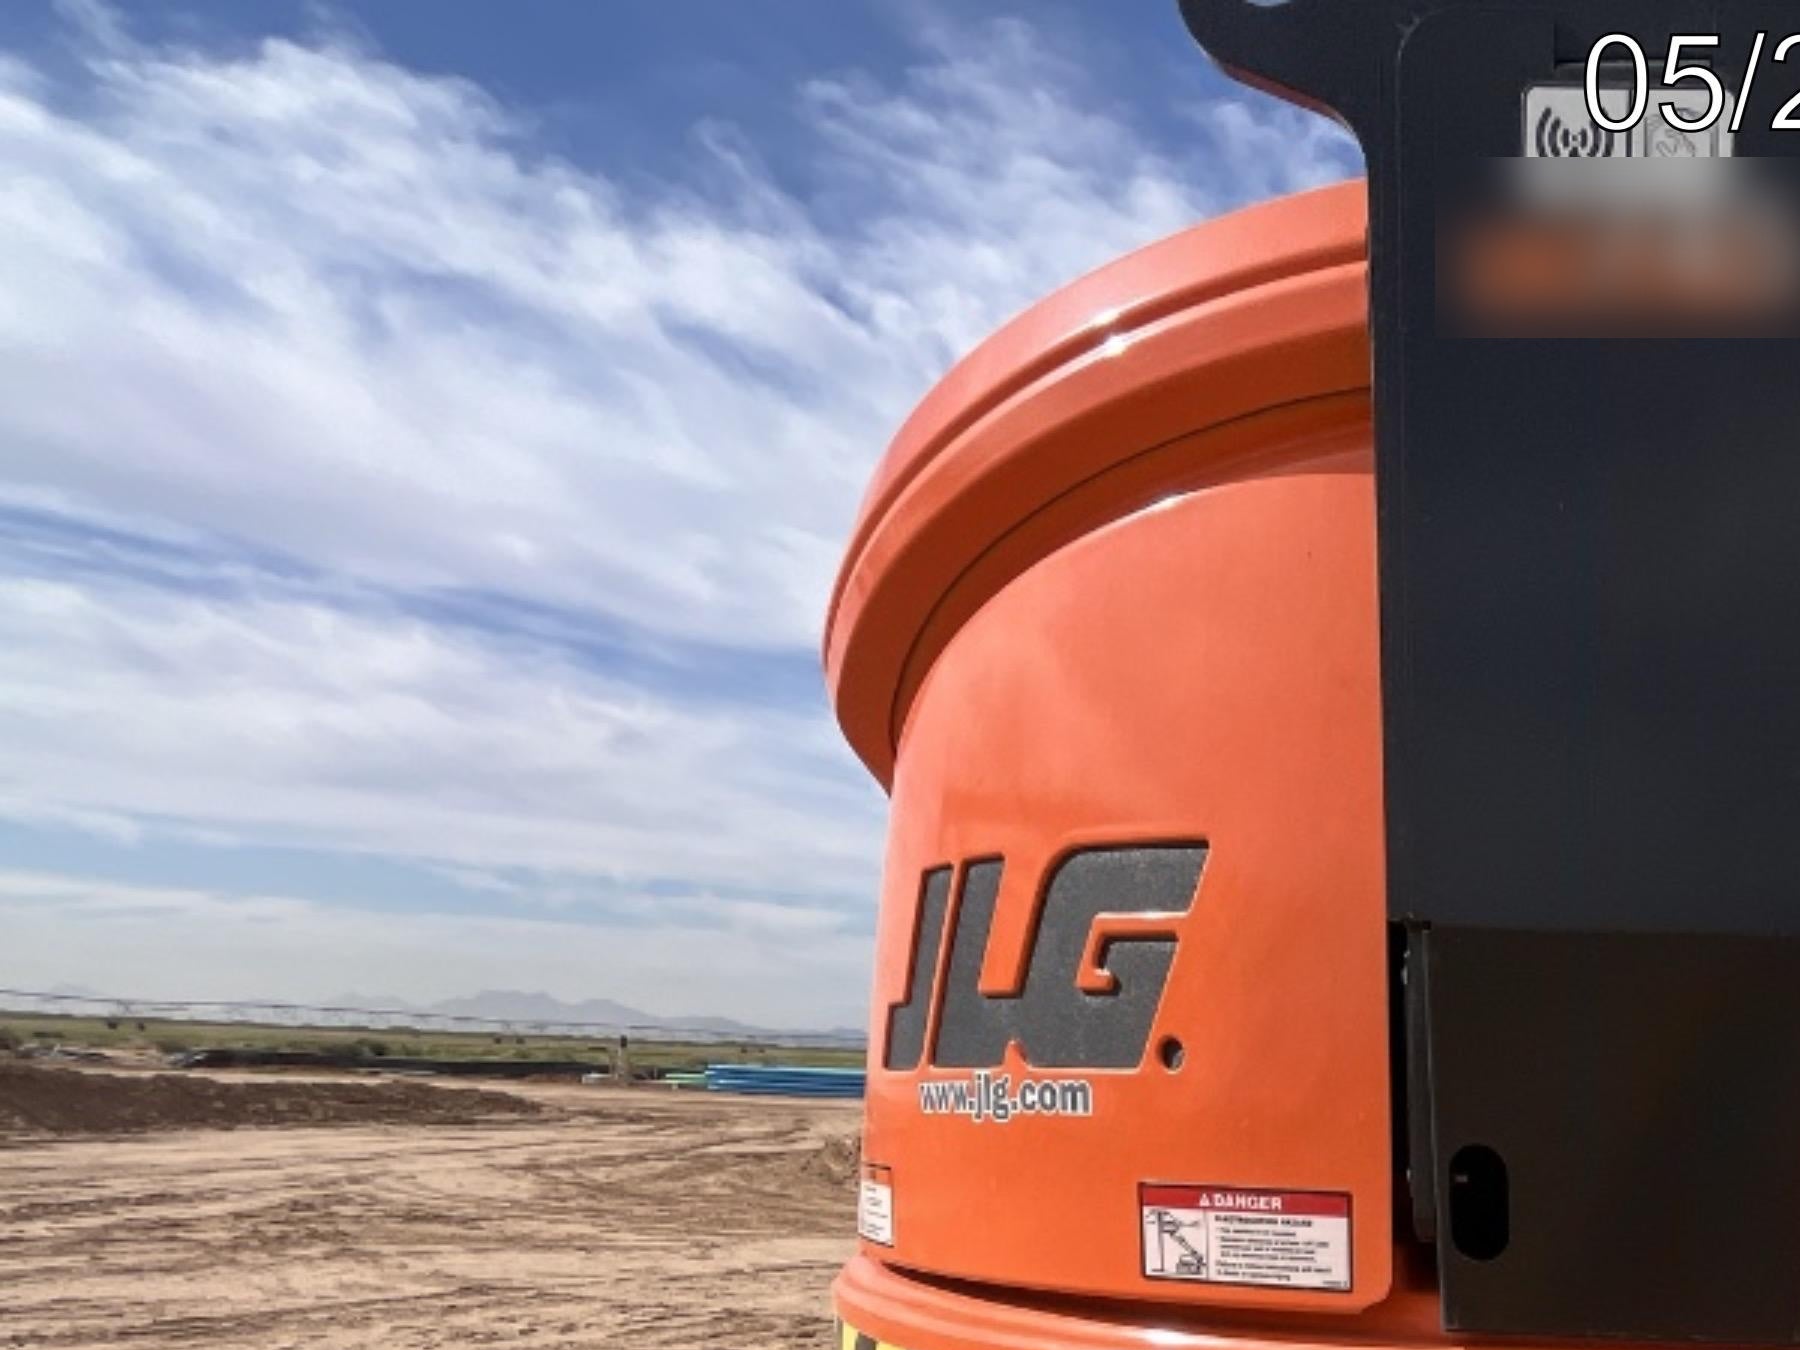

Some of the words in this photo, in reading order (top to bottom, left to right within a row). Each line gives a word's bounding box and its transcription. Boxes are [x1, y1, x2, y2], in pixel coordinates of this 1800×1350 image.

[884, 840, 1210, 1071] JLG
[919, 1075, 1092, 1121] www.jlg.com
[1213, 1193, 1282, 1210] DANGER
